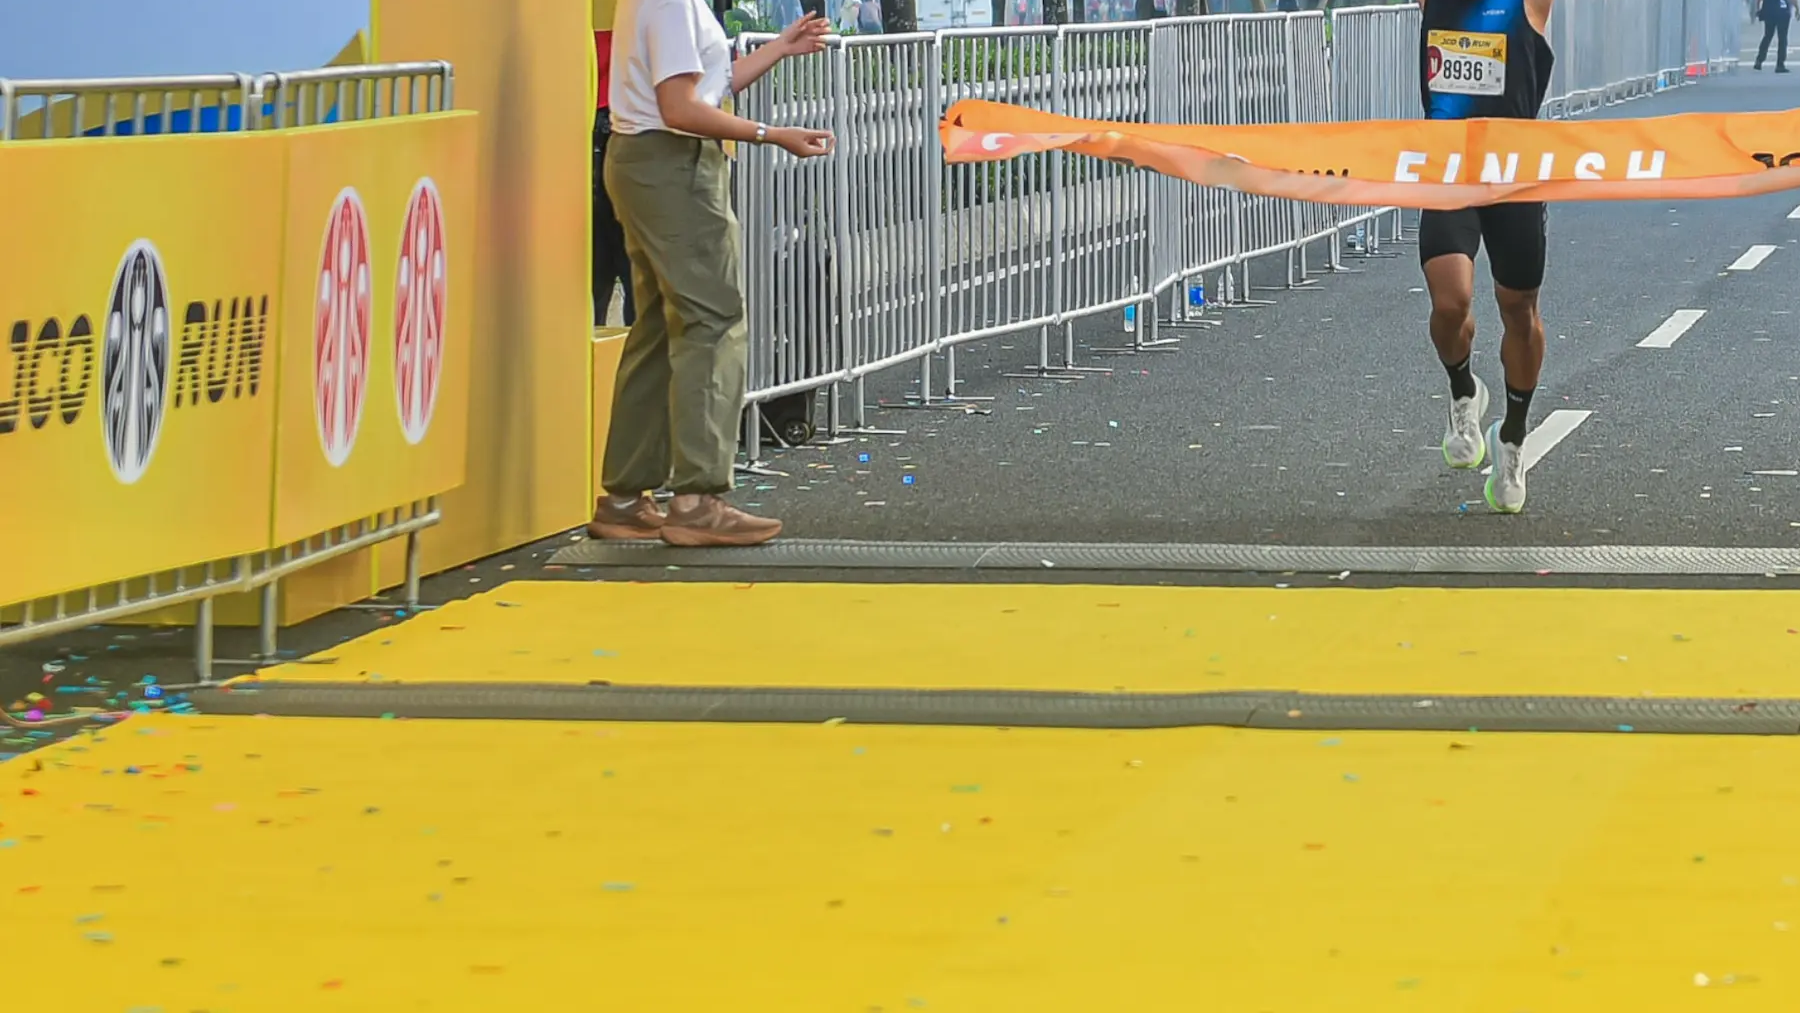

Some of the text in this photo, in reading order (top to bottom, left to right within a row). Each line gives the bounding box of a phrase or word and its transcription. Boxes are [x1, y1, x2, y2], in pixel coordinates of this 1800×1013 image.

[1443, 59, 1483, 81] 8936
[1394, 150, 1667, 184] FINISH
[0, 294, 268, 433] JCO RUN
